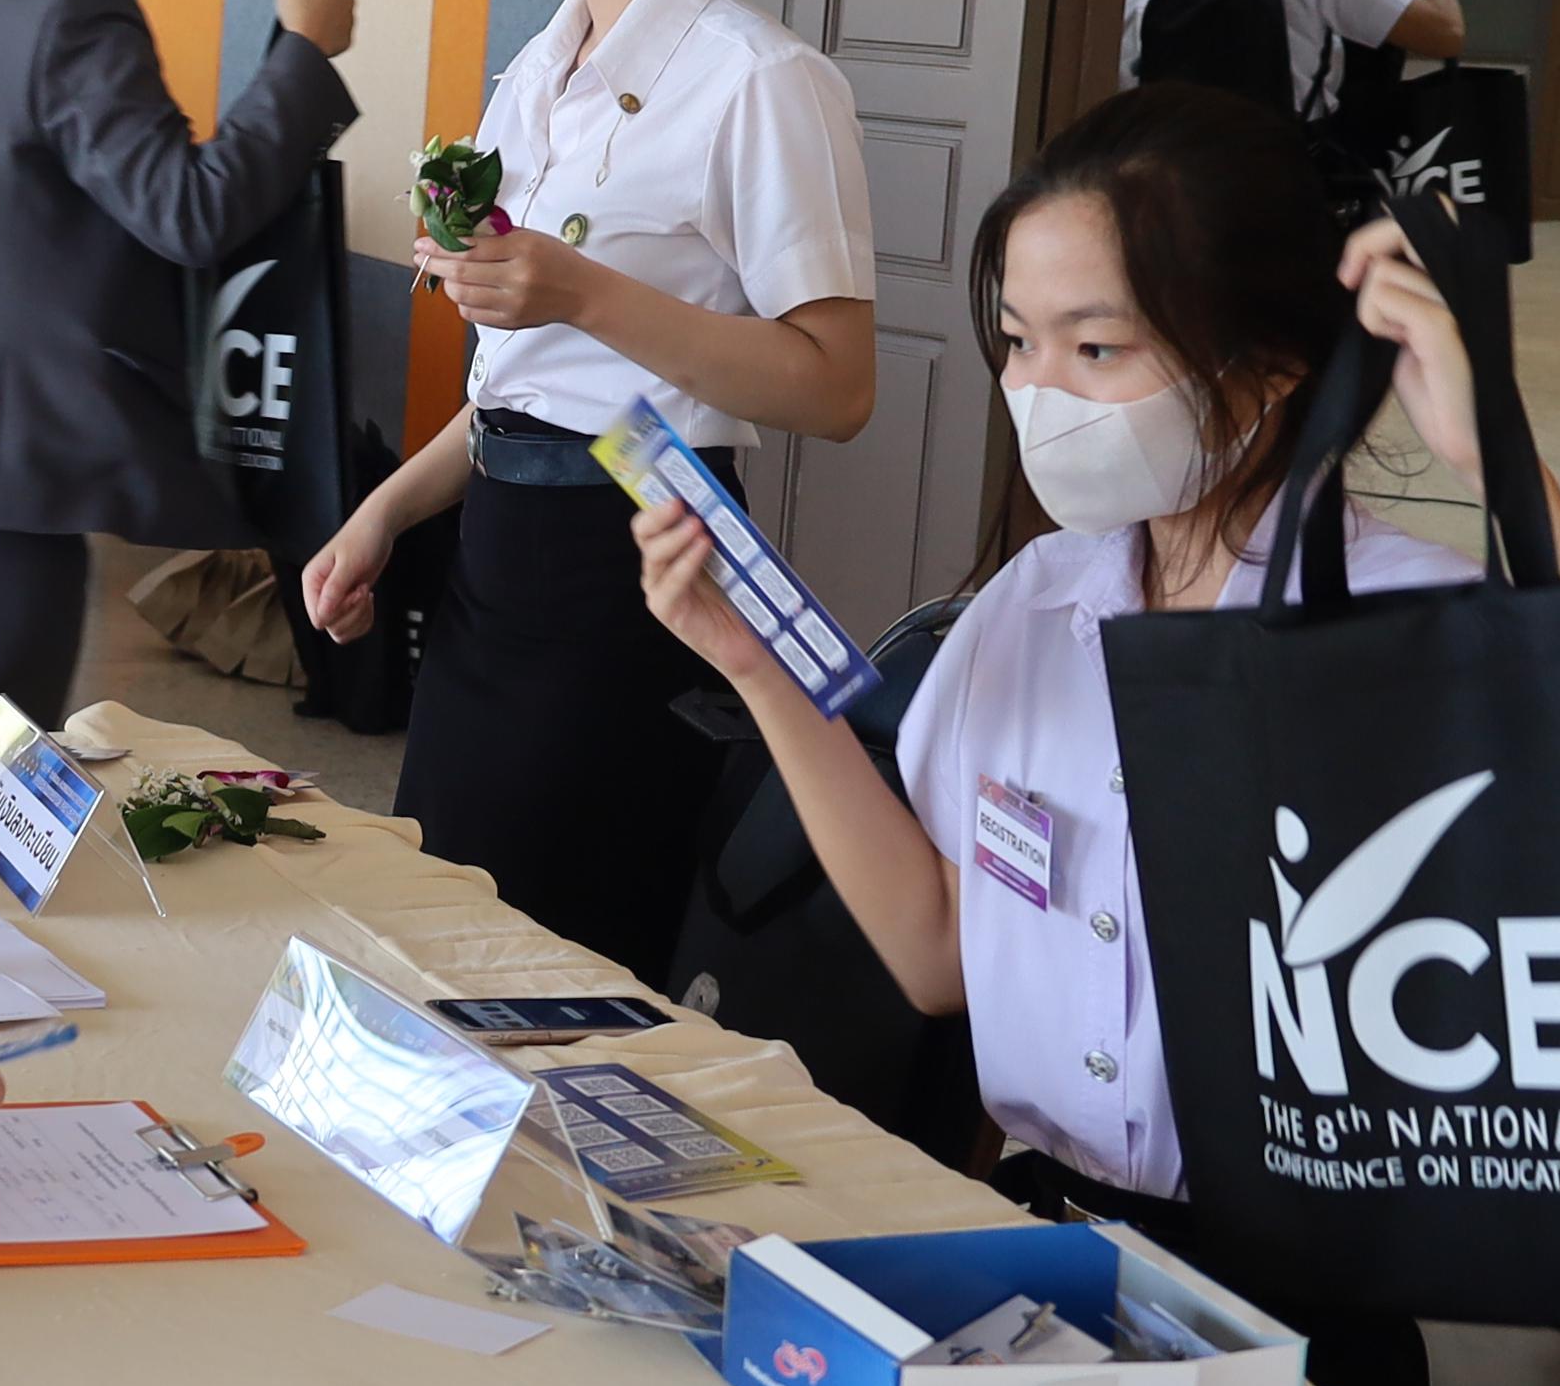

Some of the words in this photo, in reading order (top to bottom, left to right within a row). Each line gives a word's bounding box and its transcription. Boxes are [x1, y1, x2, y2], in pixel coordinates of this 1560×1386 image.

[218, 328, 297, 420] CE
[980, 811, 1047, 870] REGISTRATION
[1260, 1094, 1306, 1148] THE
[1314, 1103, 1371, 1153] 8th
[1263, 1142, 1406, 1190] CONFERENCE
[1417, 1154, 1460, 1187] ON
